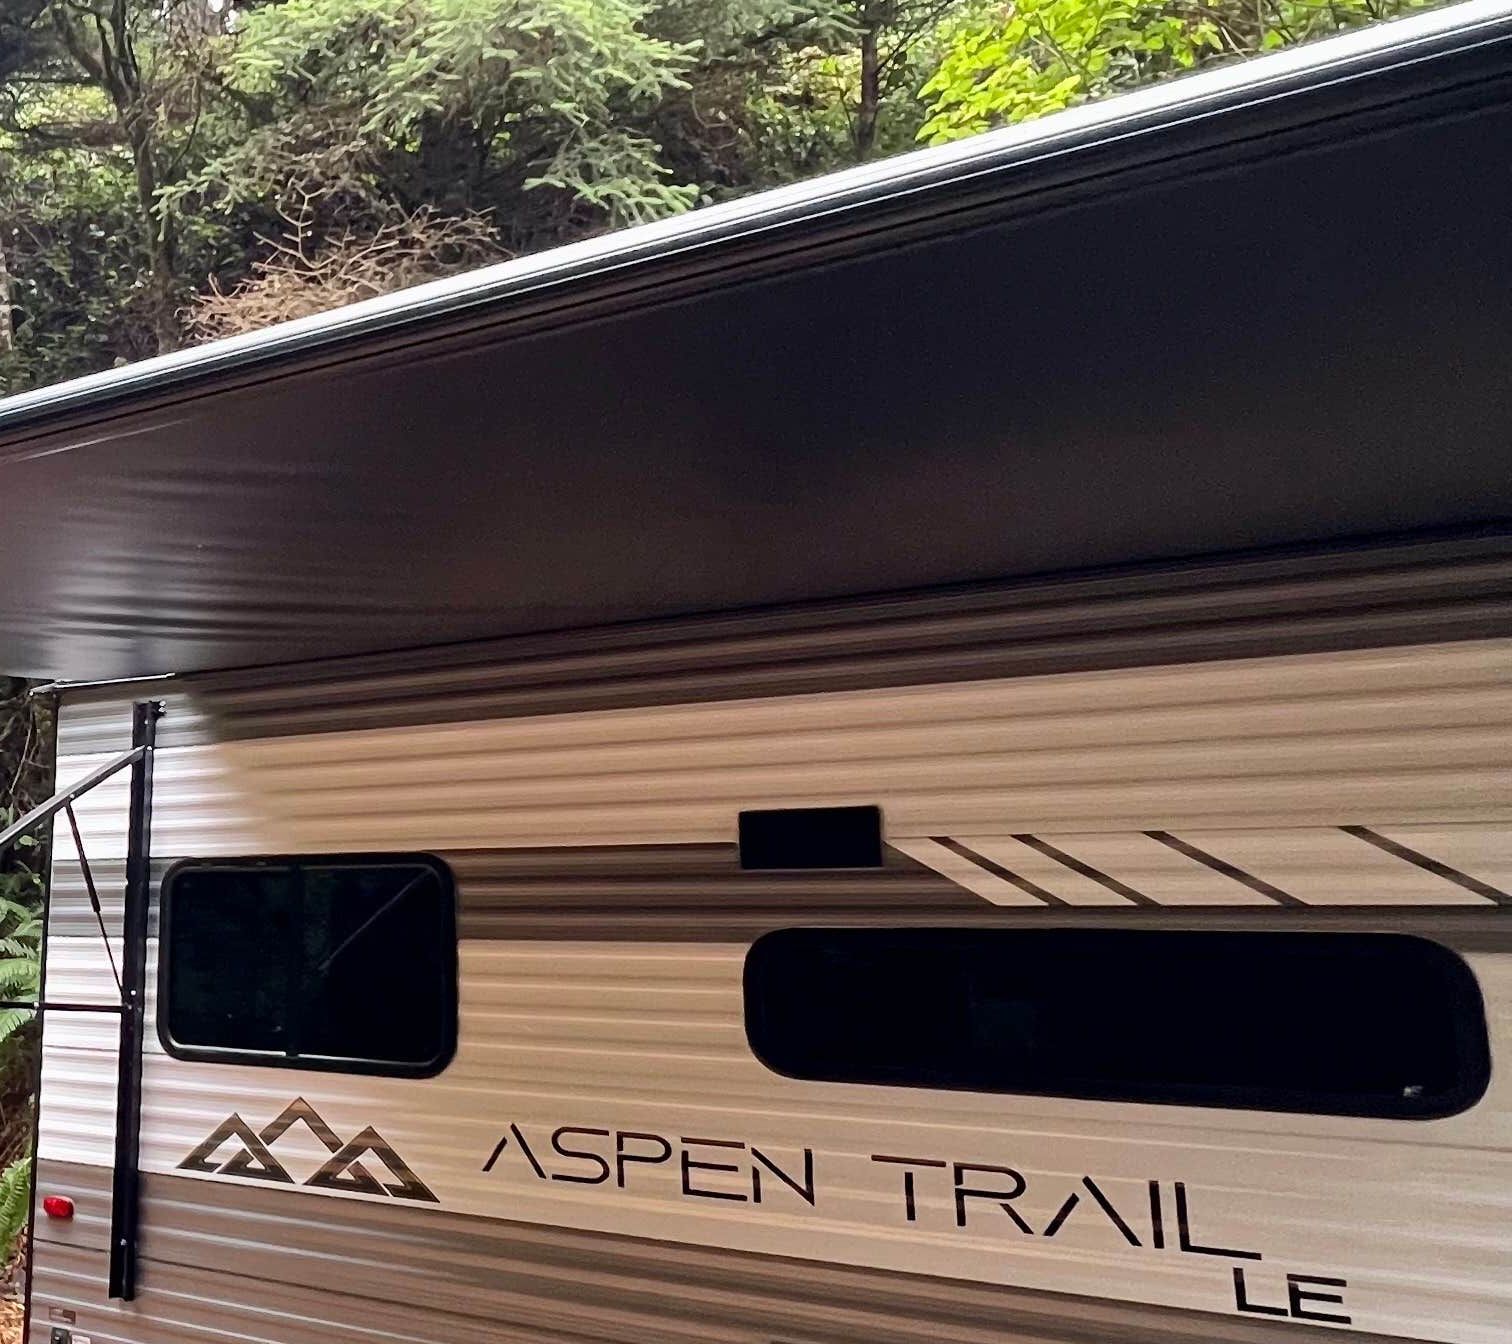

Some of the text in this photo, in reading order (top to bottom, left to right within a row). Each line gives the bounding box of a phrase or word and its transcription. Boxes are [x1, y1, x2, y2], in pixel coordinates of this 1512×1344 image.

[482, 1122, 1262, 1260] ASPEN TRAIL
[1233, 1267, 1352, 1324] LE
